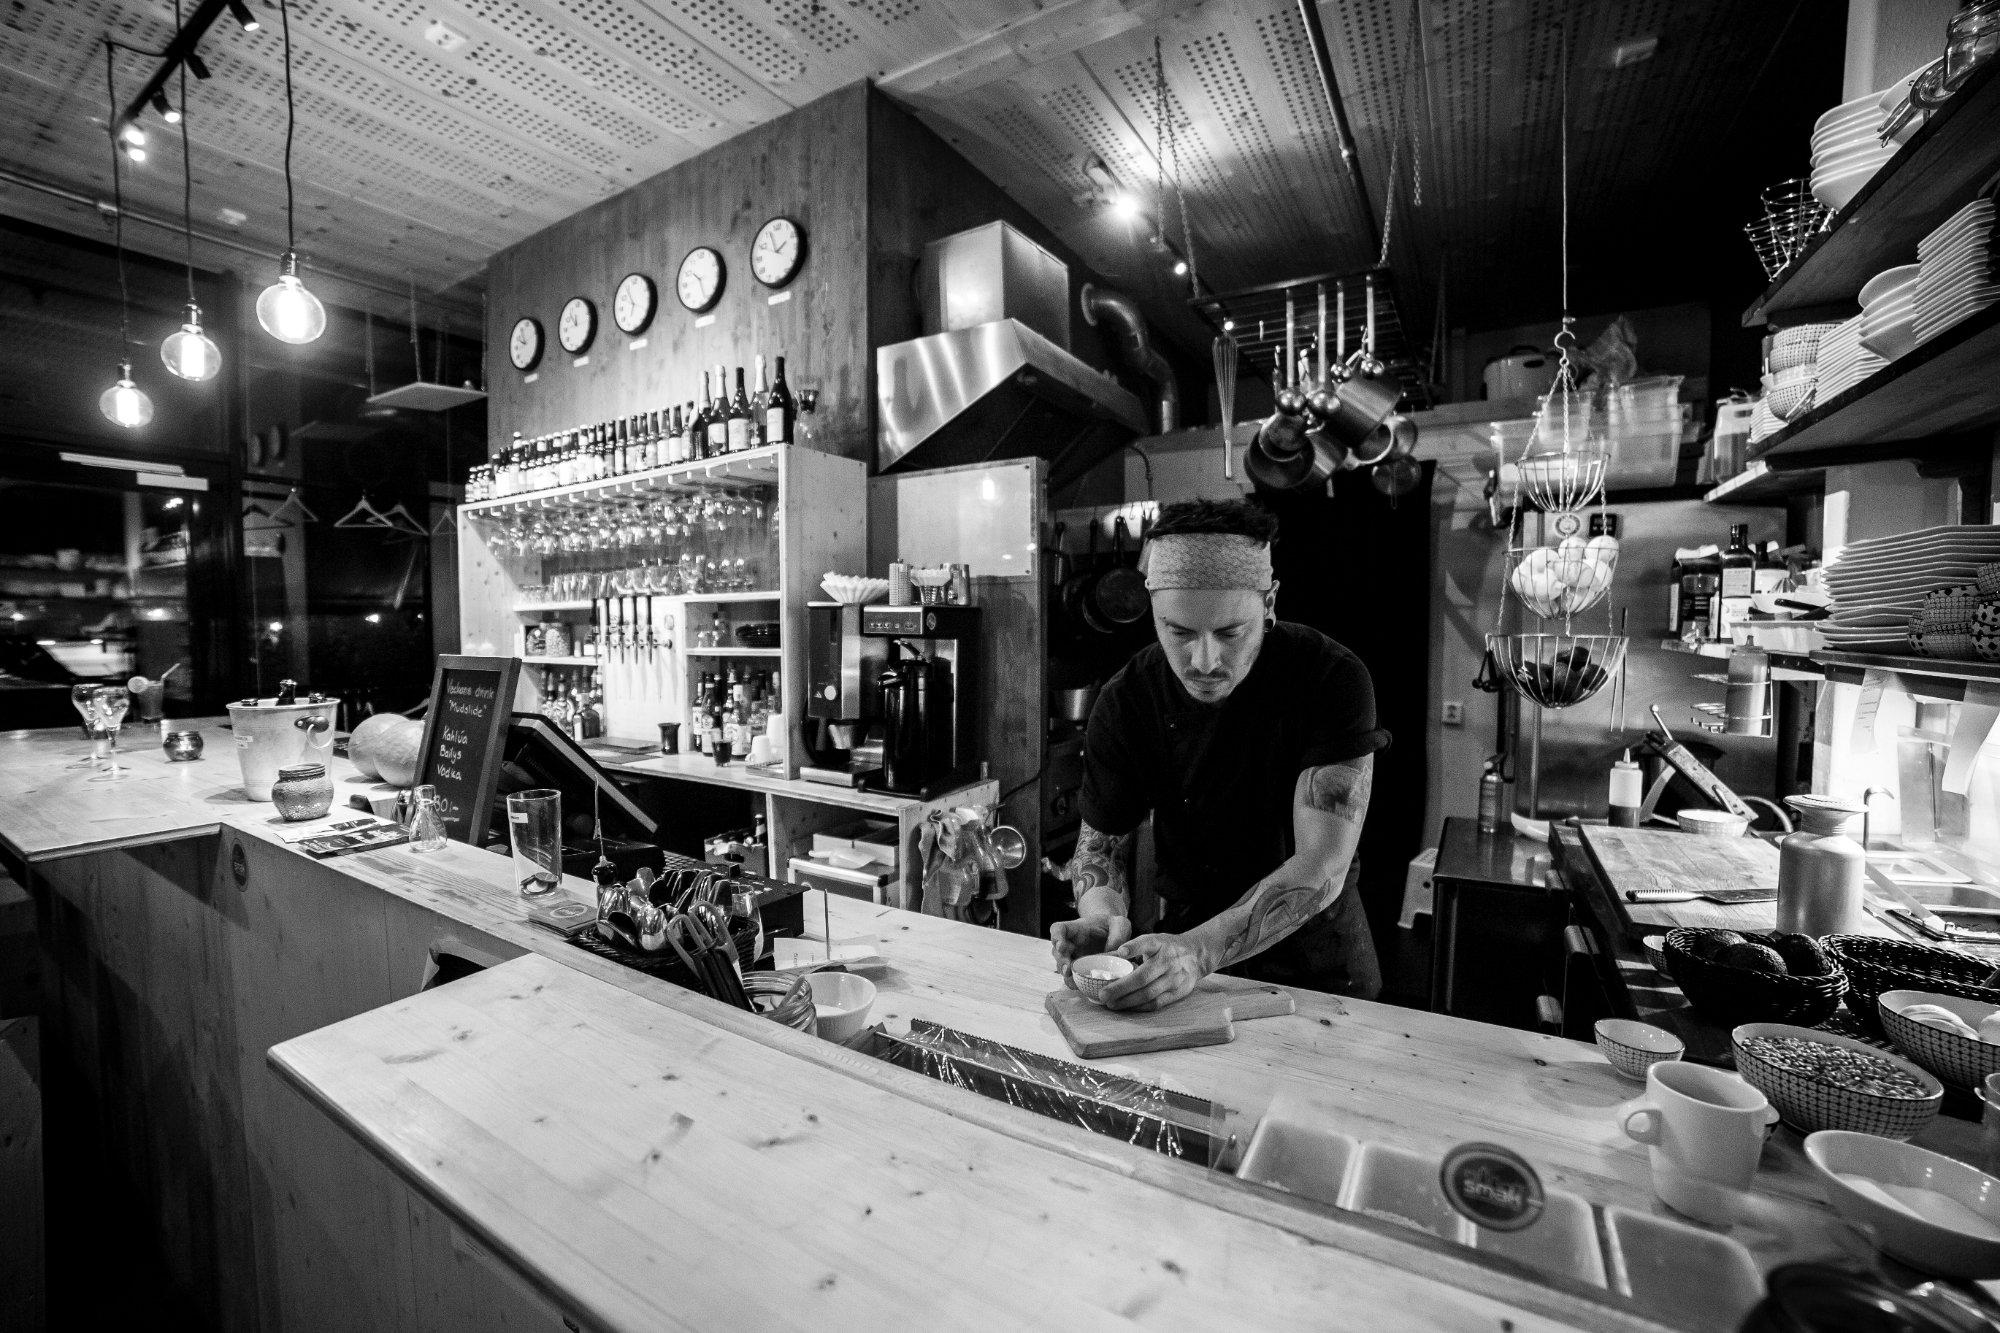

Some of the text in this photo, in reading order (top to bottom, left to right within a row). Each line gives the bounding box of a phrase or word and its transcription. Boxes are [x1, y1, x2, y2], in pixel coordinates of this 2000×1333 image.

[474, 684, 495, 700] drink
[439, 744, 462, 764] Bailys
[437, 763, 462, 781] Vodka
